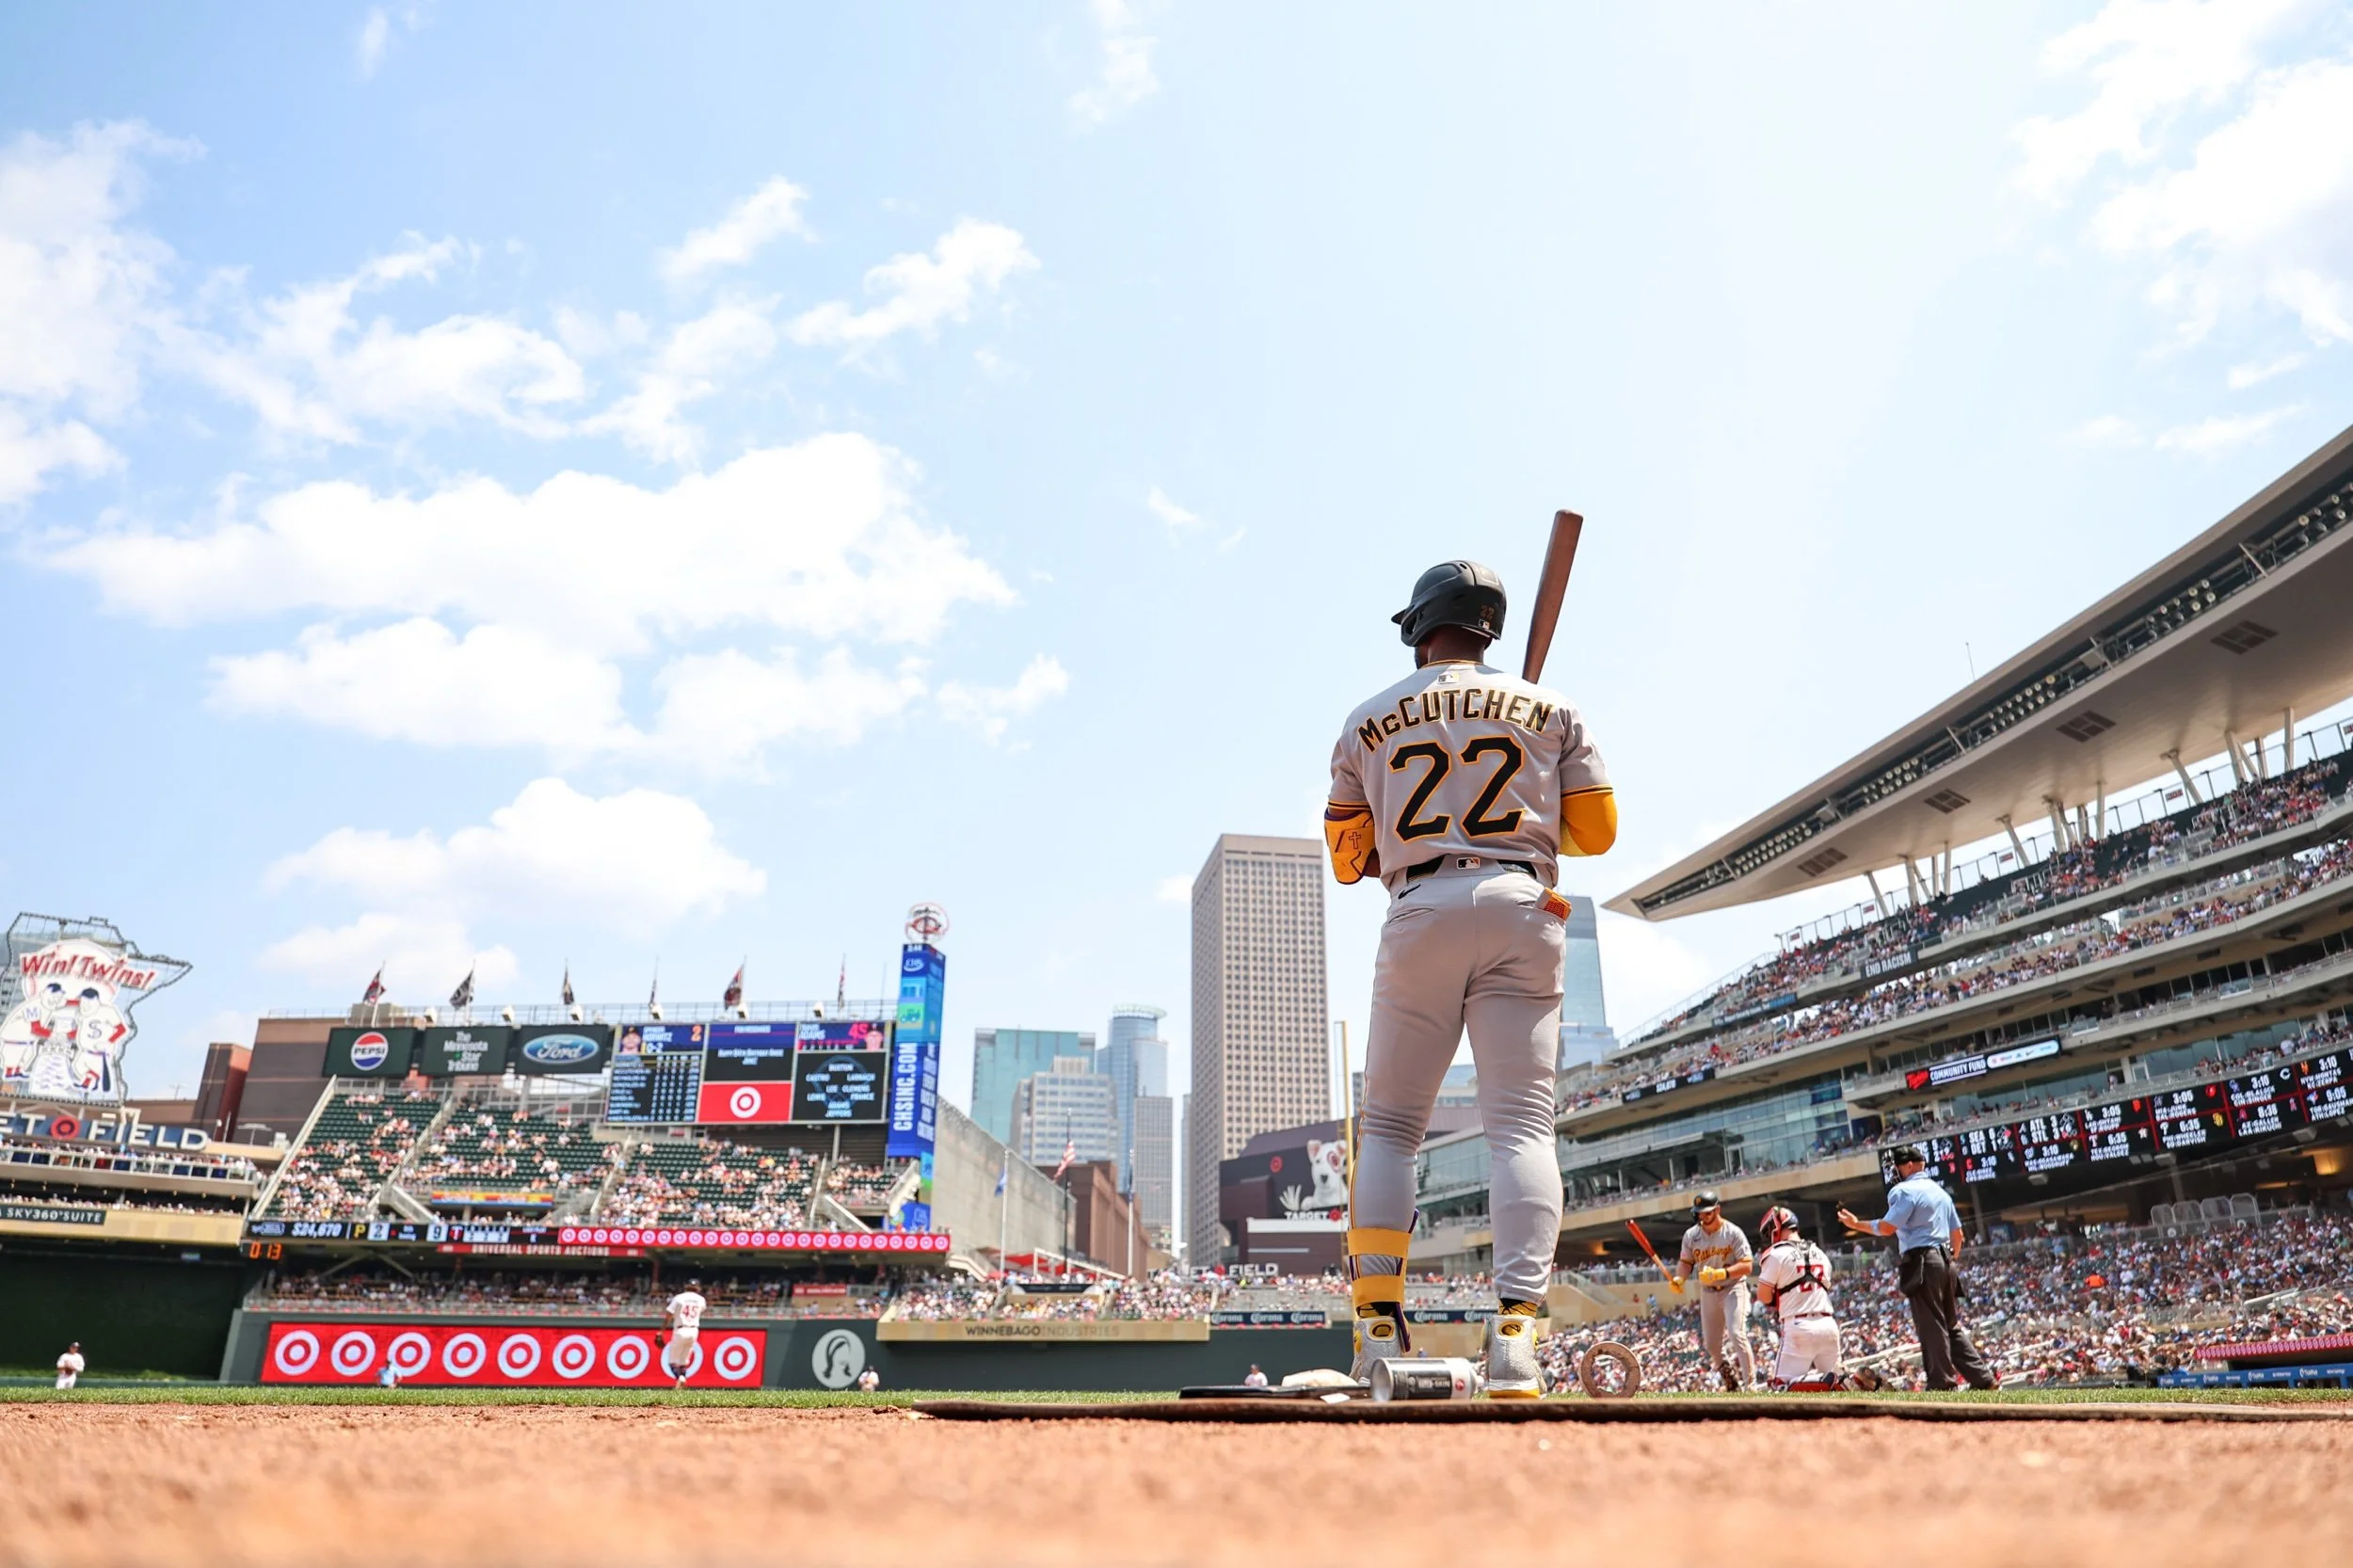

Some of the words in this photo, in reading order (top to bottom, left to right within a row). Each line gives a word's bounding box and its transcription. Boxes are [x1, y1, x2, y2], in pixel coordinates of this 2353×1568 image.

[1356, 688, 1553, 752] McCUTCHEN
[1388, 735, 1525, 844] 22
[23, 952, 77, 974] Win!
[81, 956, 156, 987] Twins!
[1865, 962, 1881, 978] END
[1881, 952, 1912, 973] RACISM
[354, 1047, 385, 1056] PEPSI
[443, 1040, 488, 1052] Minnesota
[537, 1039, 584, 1059] Ford
[1930, 1064, 1967, 1081] COMMUNITY
[1968, 1058, 1986, 1072] FUND
[2319, 1055, 2337, 1071] 3:10
[893, 1042, 918, 1131] CHSINC.COM
[2251, 1074, 2269, 1089] 3:10
[2172, 1090, 2193, 1104] 3:05
[2102, 1104, 2121, 1118] 3:05
[2030, 1118, 2046, 1132] ATL
[2050, 1115, 2057, 1128] 3
[88, 1118, 209, 1150] FIELD
[1969, 1129, 1985, 1144] SEA
[2031, 1129, 2048, 1144] STL
[1971, 1142, 1986, 1155] DET
[2042, 1144, 2058, 1157] 3:10
[1981, 1156, 1996, 1167] 3:10
[1284, 1210, 1329, 1222] TARGET
[292, 1222, 342, 1239] $24,670
[472, 1243, 521, 1255] UNIVERSAL
[525, 1244, 561, 1256] SPORTS
[564, 1245, 610, 1256] AUCTIONS
[1694, 1244, 1733, 1263] Pittsburgh
[1229, 1263, 1279, 1276] FIELD
[681, 1304, 699, 1319] 45
[1211, 1312, 1243, 1323] Corona
[1250, 1311, 1284, 1323] Corona
[1290, 1311, 1323, 1322] Corona
[1414, 1311, 1449, 1322] Corona
[966, 1325, 1040, 1336] WINNEBAGO
[1041, 1325, 1120, 1337] INDUSTRIES
